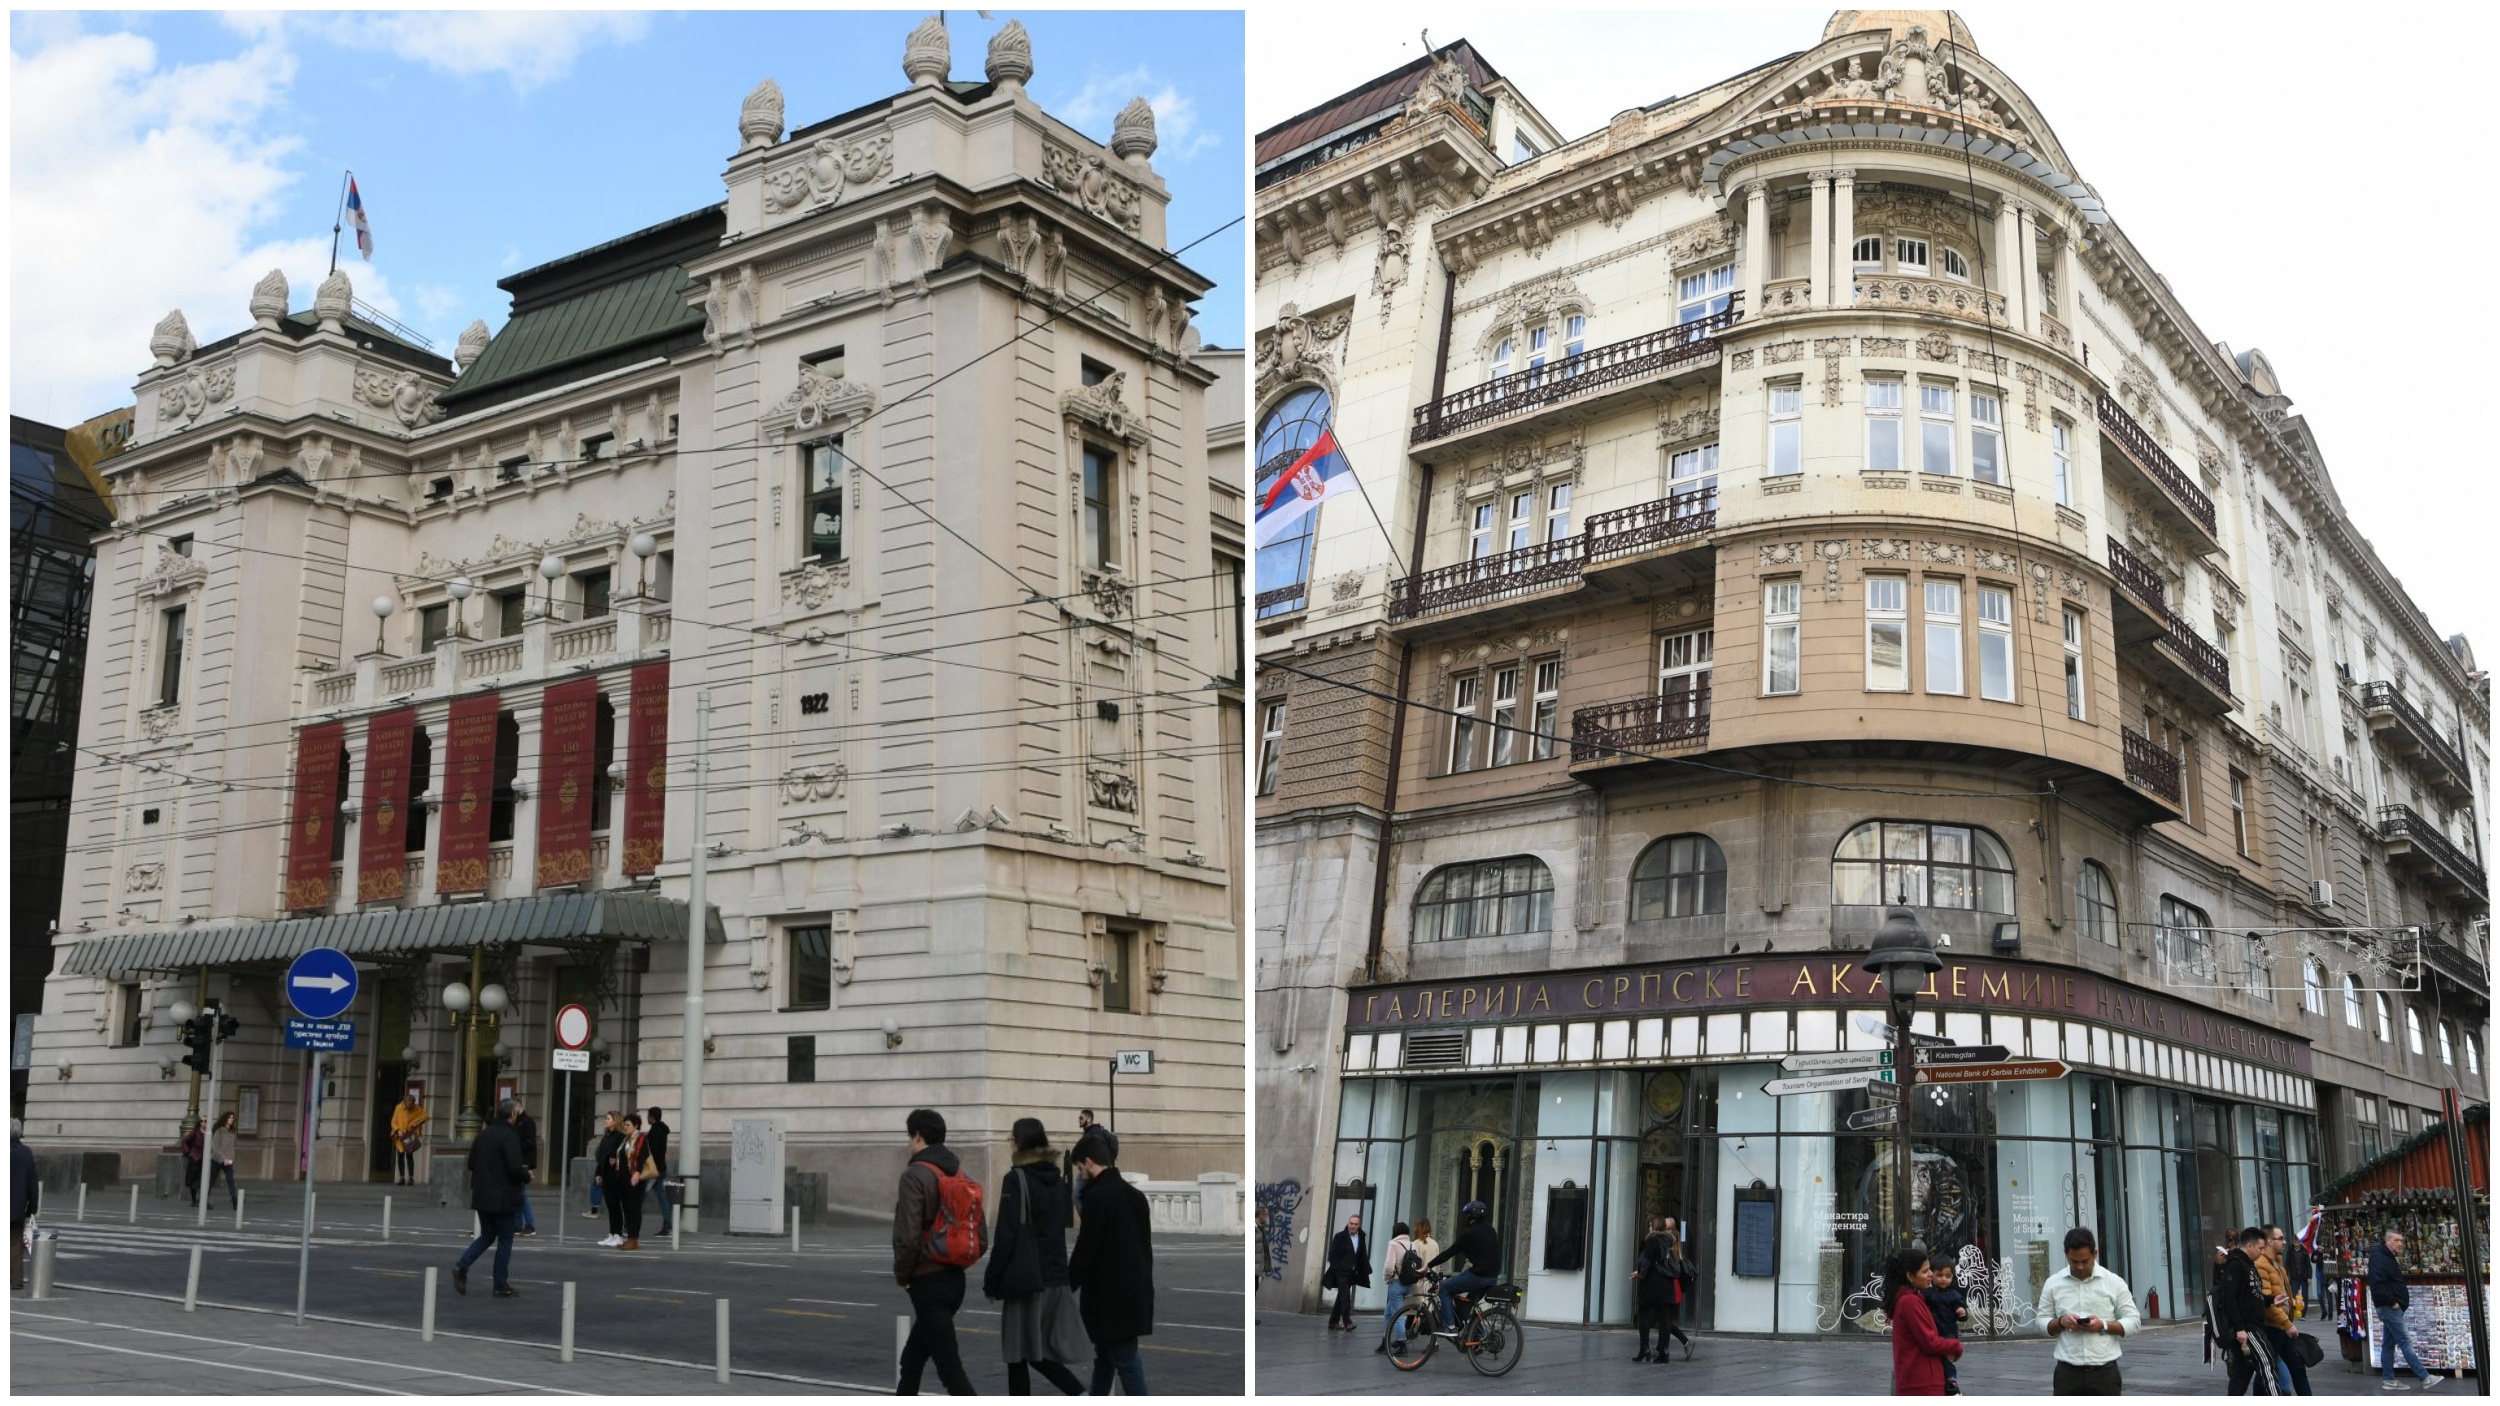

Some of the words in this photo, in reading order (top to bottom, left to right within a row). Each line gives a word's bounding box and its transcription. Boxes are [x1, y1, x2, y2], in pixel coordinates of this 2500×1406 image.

[801, 692, 829, 715] 1922
[1366, 984, 1550, 1022] ГАЛЕРИЈА
[1583, 967, 1750, 1009] СРПСКЕ
[2096, 985, 2167, 1031] НАУКА
[2180, 1011, 2191, 1038] И
[2203, 1017, 2297, 1066] УМЕТНОСТИ
[1124, 1054, 1141, 1065] WC
[1935, 1051, 1976, 1060] Kalemegdan
[1935, 1070, 1963, 1079] National
[1963, 1070, 1981, 1078] Bank
[1990, 1068, 2013, 1076] Serbia
[2013, 1067, 2048, 1076] Exhibition
[1782, 1082, 1805, 1090] Tourism
[1806, 1078, 1844, 1089] Organisation
[1844, 1076, 1851, 1084] of
[1852, 1076, 1869, 1084] Serbi
[1814, 1210, 1869, 1222] Манастира
[2013, 1213, 2050, 1224] Monastery
[1814, 1221, 1868, 1231] Студенице
[2013, 1224, 2021, 1233] of
[2022, 1224, 2055, 1233] Studenica
